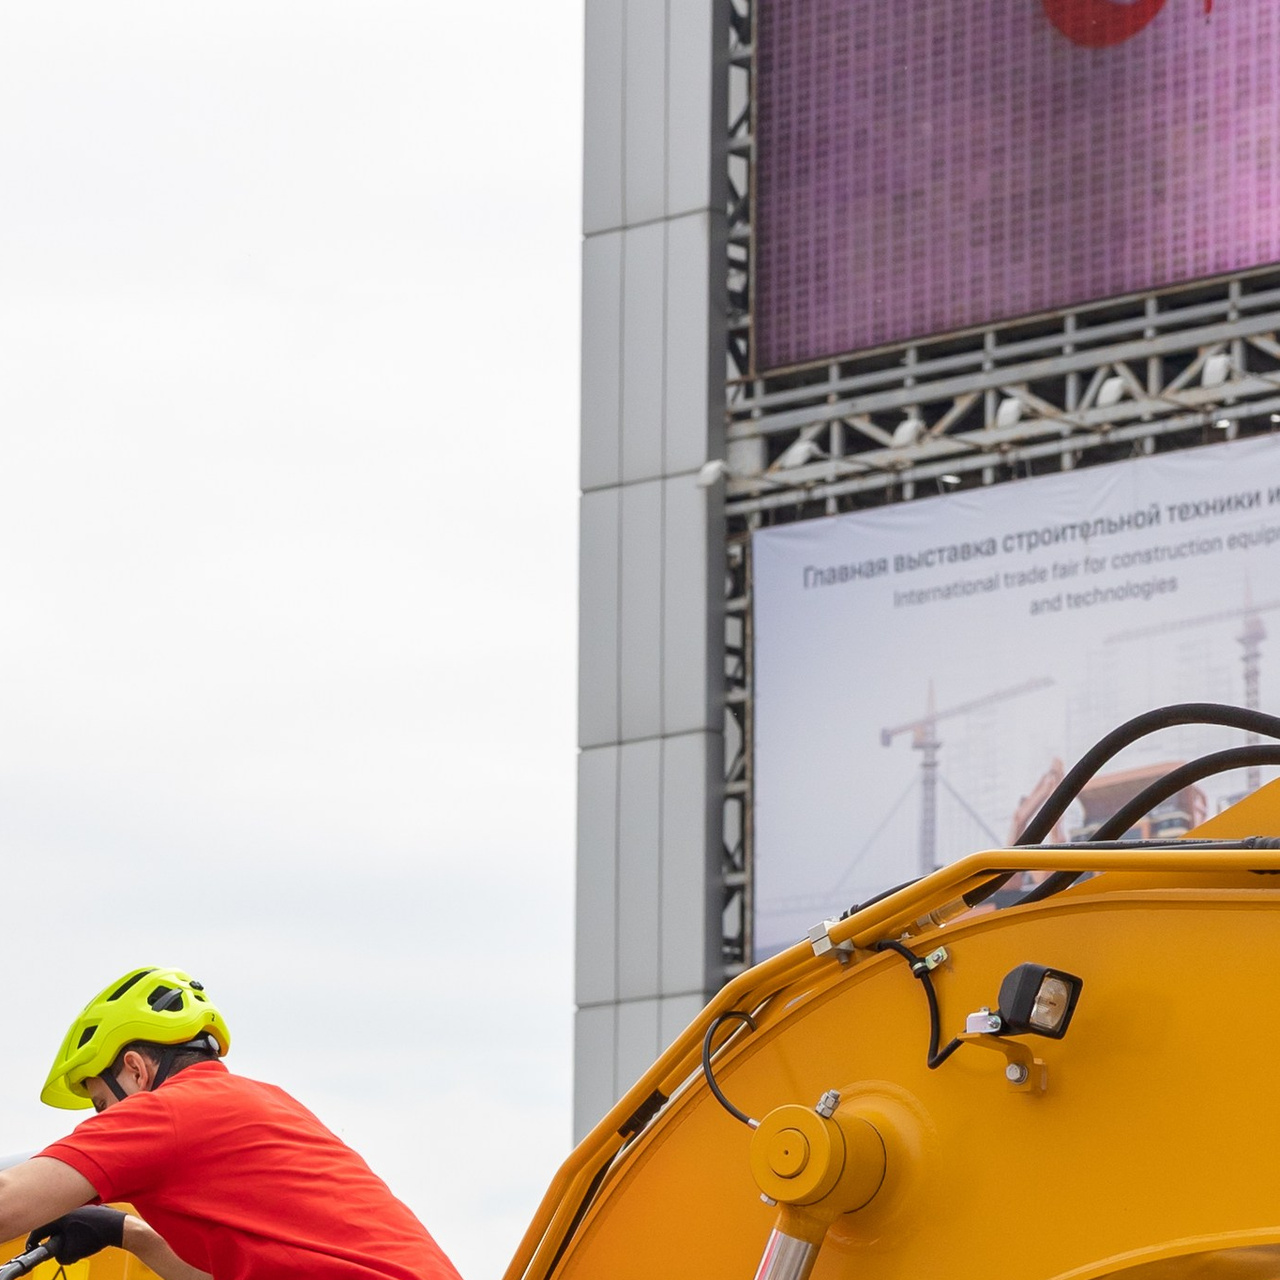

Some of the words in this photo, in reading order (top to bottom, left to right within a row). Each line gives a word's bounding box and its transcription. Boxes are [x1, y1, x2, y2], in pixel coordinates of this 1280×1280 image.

[803, 557, 889, 589] Главная
[893, 536, 997, 574] выставка
[1002, 501, 1161, 553] строительной
[1166, 488, 1262, 524] техники
[893, 573, 1000, 608] International
[1003, 564, 1048, 588] trade
[1052, 560, 1080, 580] fair
[1084, 555, 1106, 575] for
[1111, 535, 1224, 571] construction
[1227, 525, 1280, 552] equip
[1029, 592, 1063, 616] and
[1066, 576, 1179, 609] technologies
